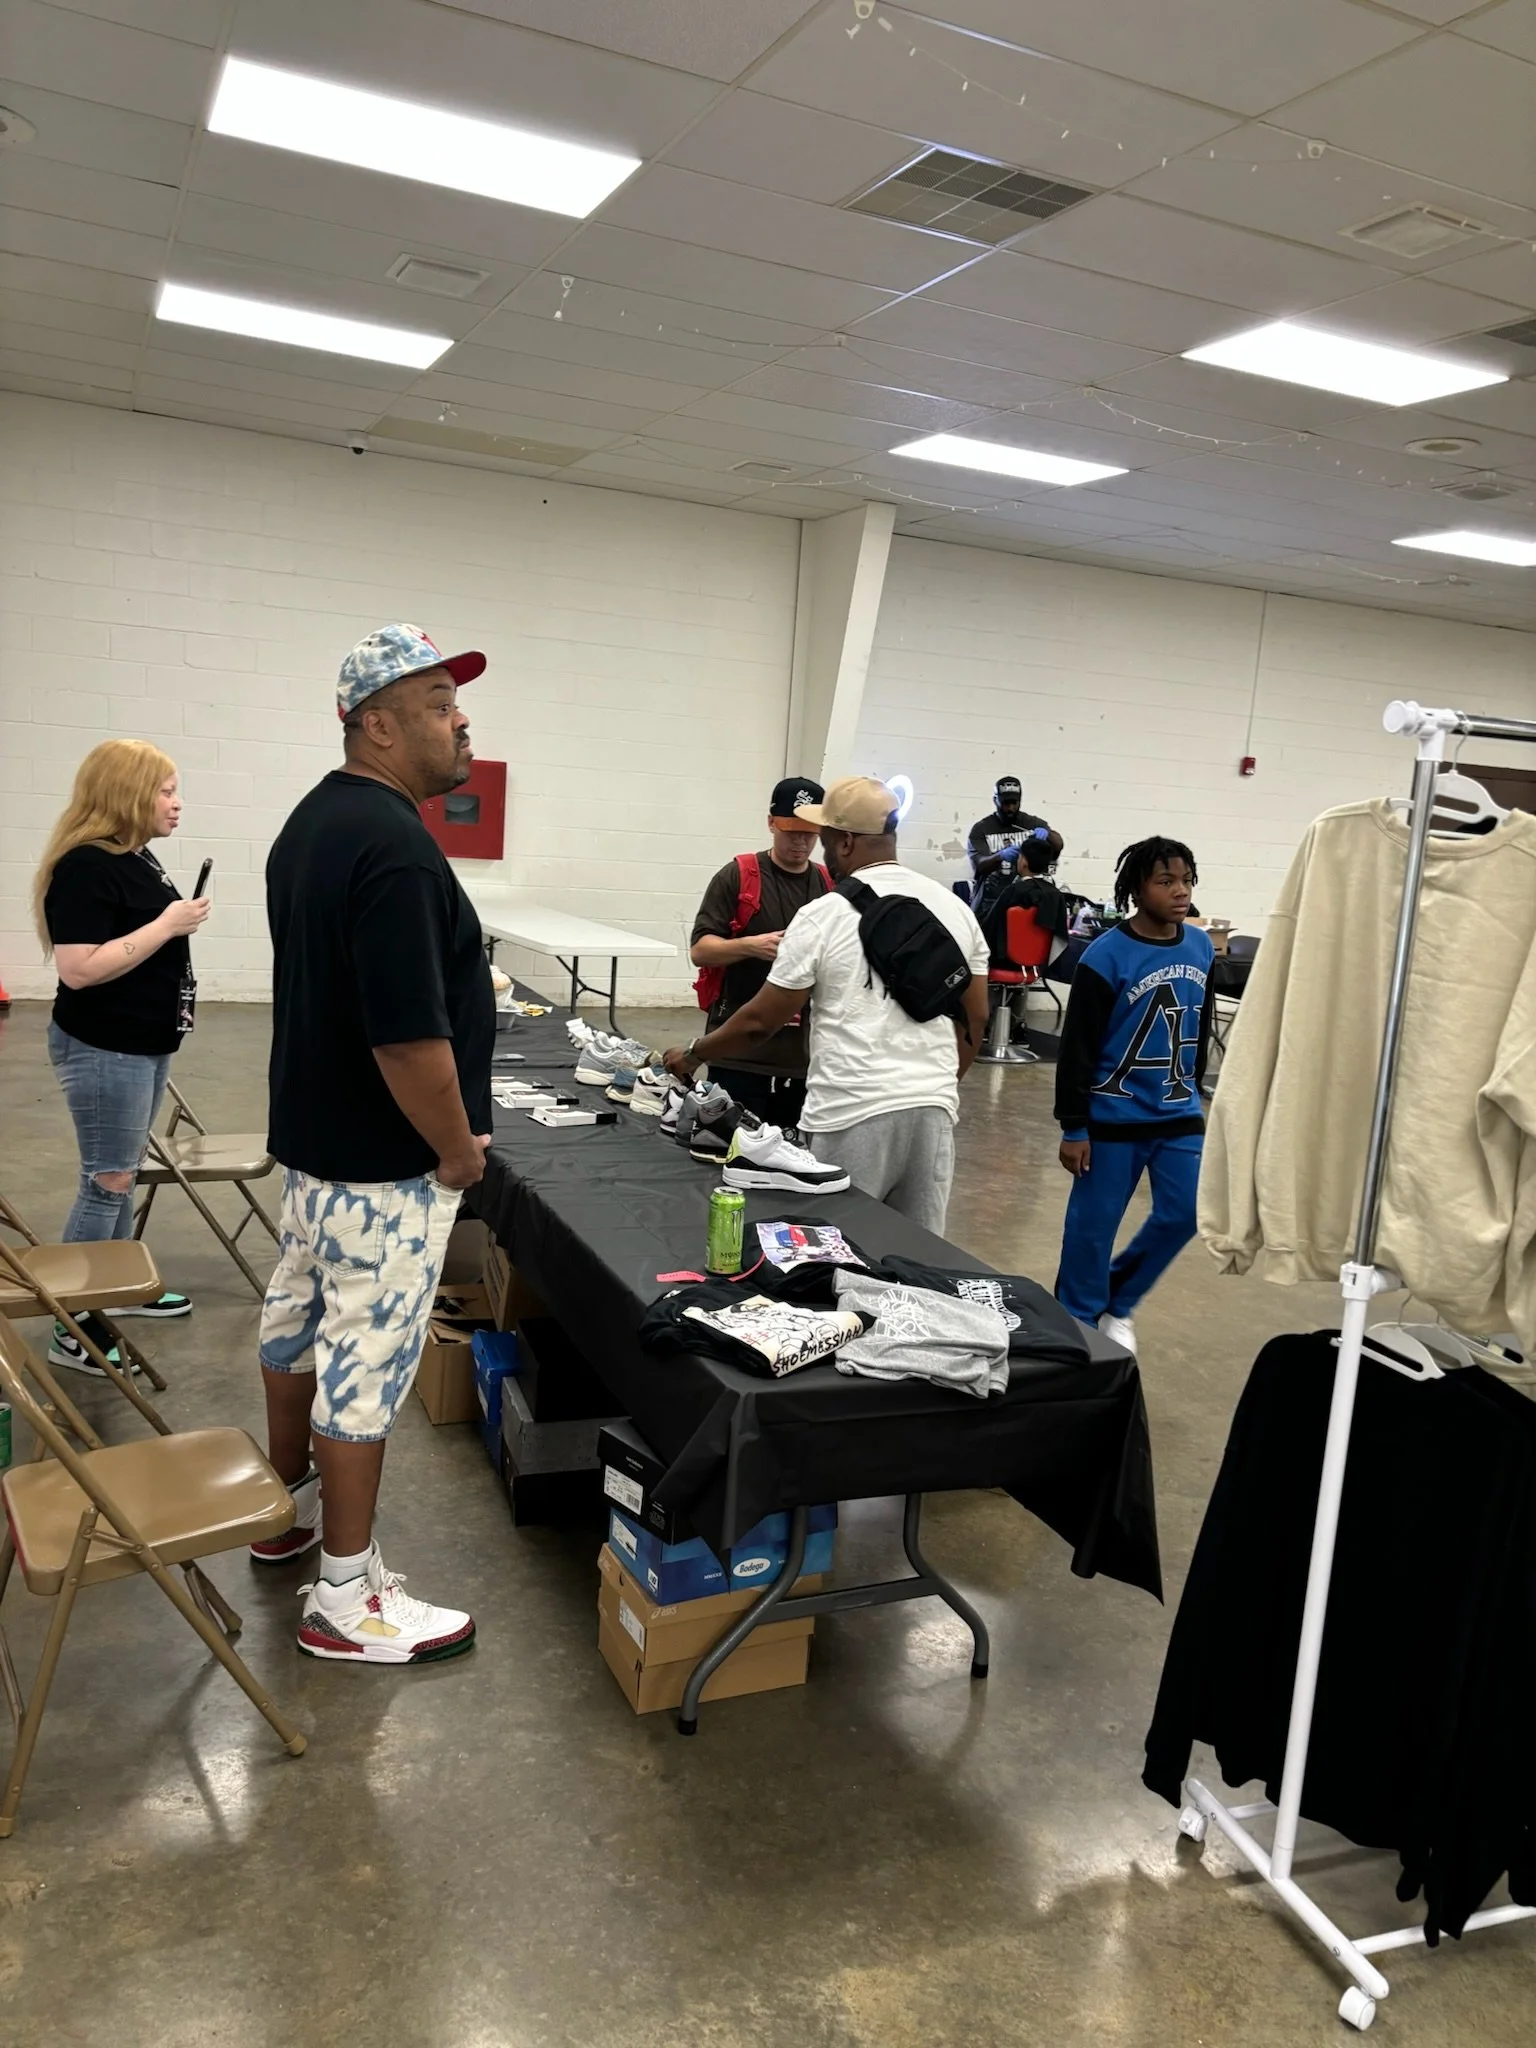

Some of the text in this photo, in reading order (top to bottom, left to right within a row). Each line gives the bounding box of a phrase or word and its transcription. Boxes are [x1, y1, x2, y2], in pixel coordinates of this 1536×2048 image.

[1126, 965, 1184, 1005] AMERICAN
[773, 1324, 862, 1374] SHOEMESSIAH
[739, 1563, 764, 1574] Bodega
